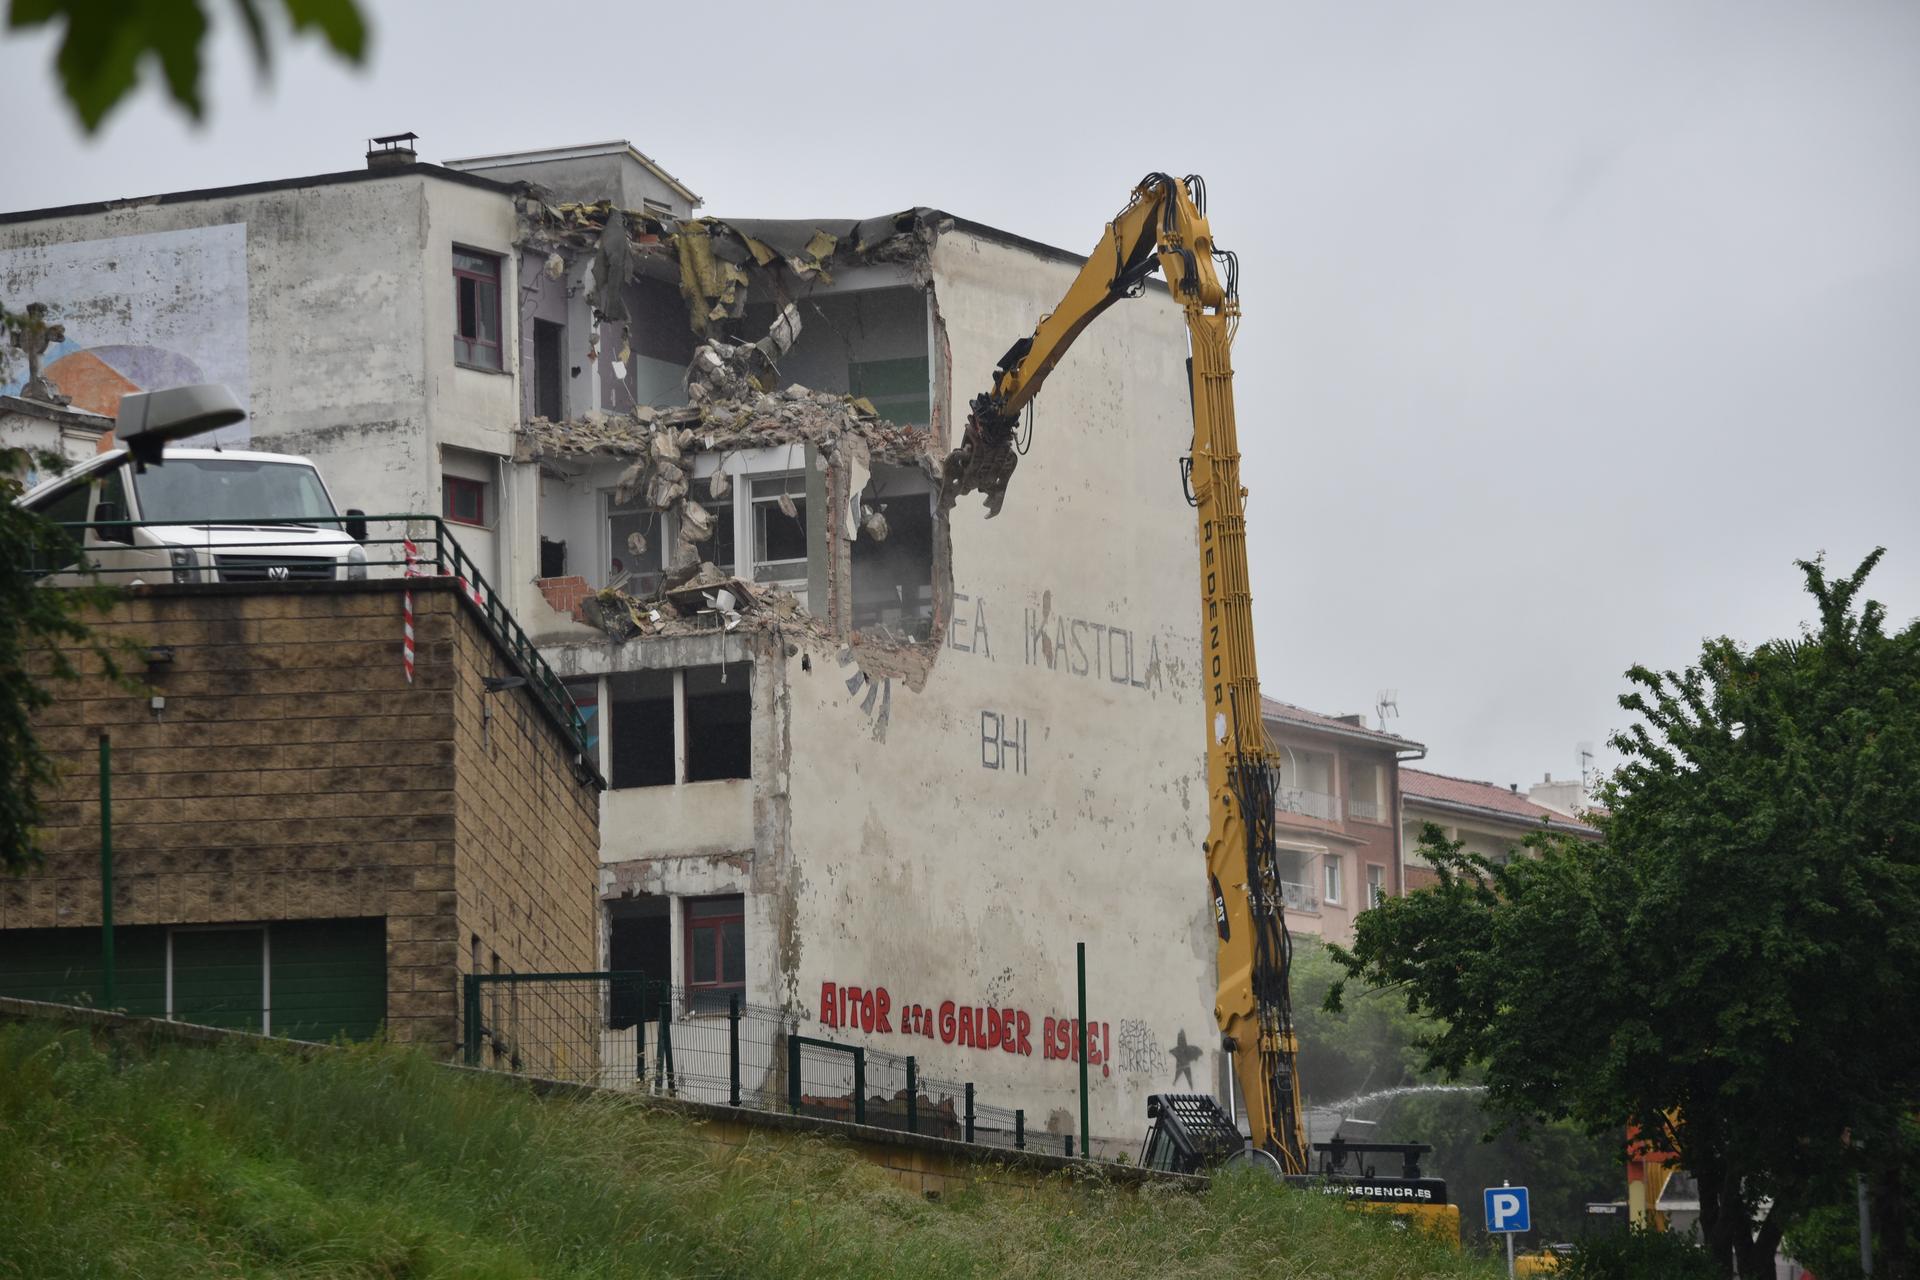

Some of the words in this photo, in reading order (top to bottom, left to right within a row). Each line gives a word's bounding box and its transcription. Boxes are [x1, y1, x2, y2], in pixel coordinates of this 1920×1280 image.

[1203, 519, 1224, 706] REDENOR
[1024, 606, 1164, 693] IKASTOLA
[980, 709, 1028, 776] BHI
[1215, 896, 1226, 922] CAT
[819, 981, 893, 1034] AITOR
[901, 1004, 935, 1039] ETA
[938, 1000, 1033, 1057] GALDER
[1493, 1194, 1520, 1228] P
